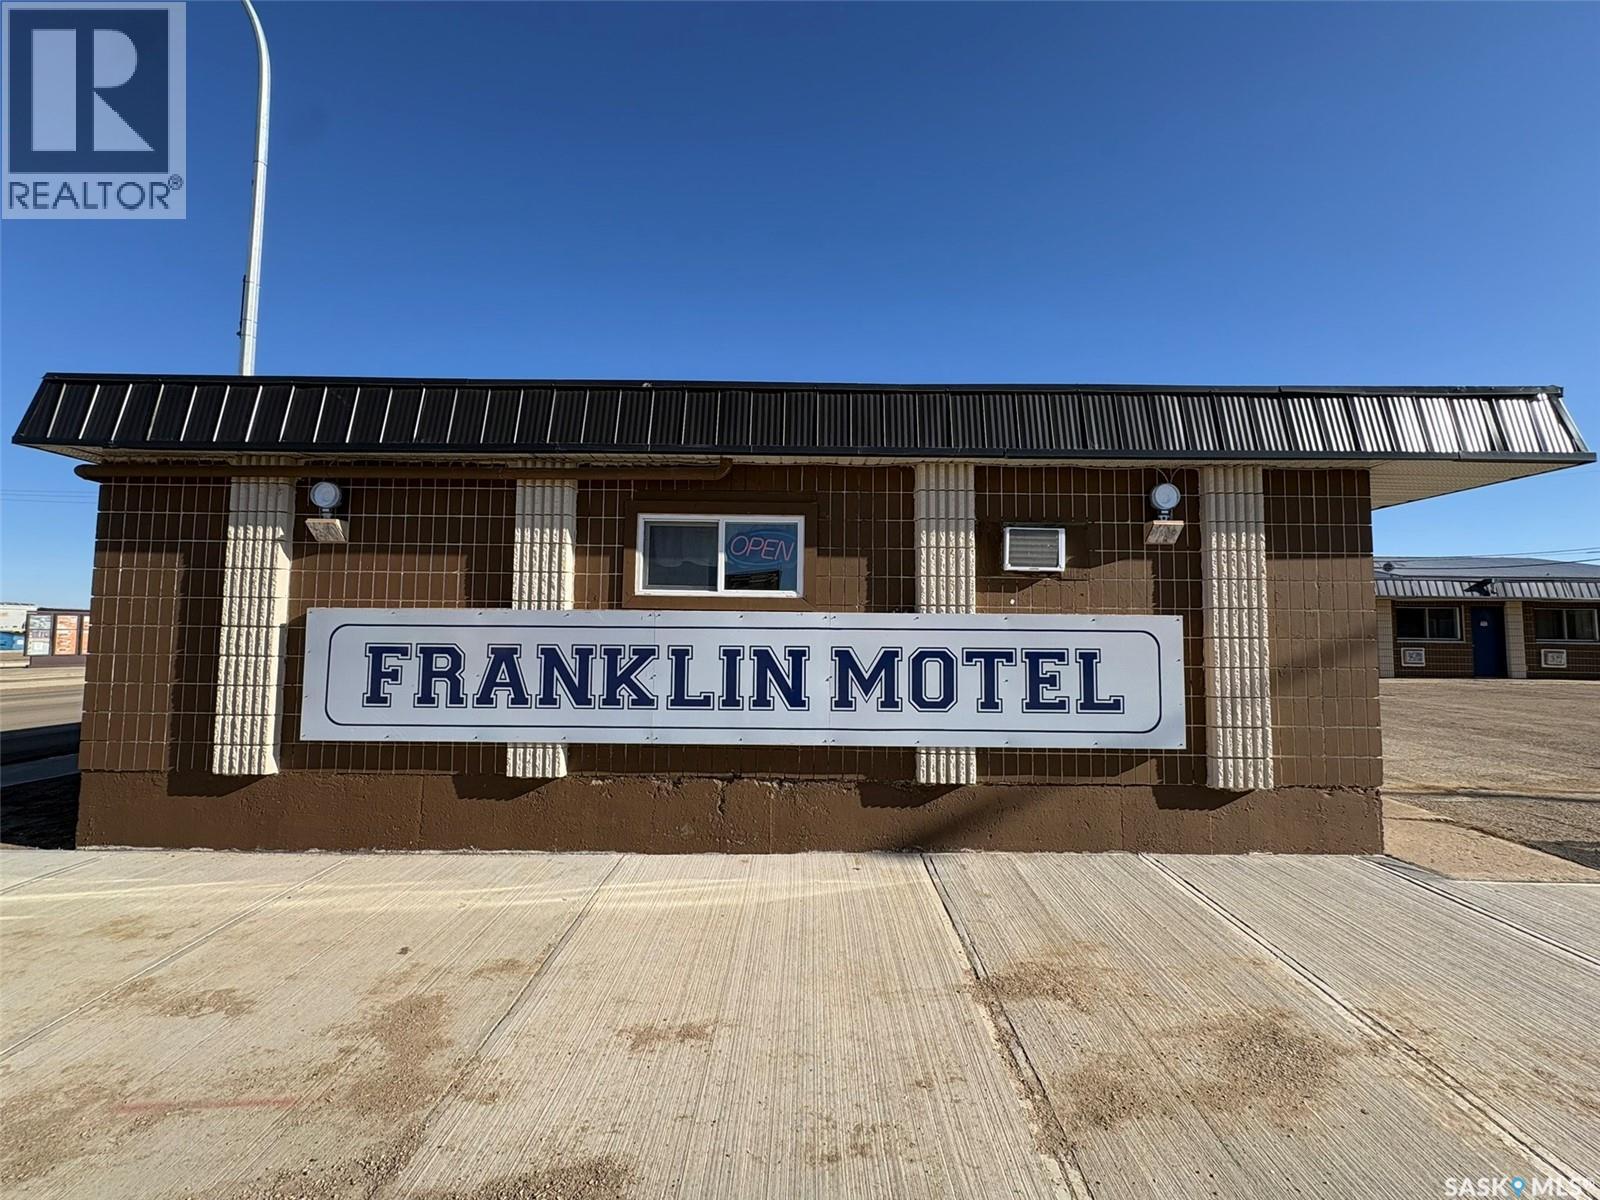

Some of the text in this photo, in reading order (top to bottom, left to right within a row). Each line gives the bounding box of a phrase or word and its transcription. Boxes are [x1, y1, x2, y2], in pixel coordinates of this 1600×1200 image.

[731, 535, 795, 561] OPEN
[362, 642, 1125, 714] FRANKLIN MOTEL
